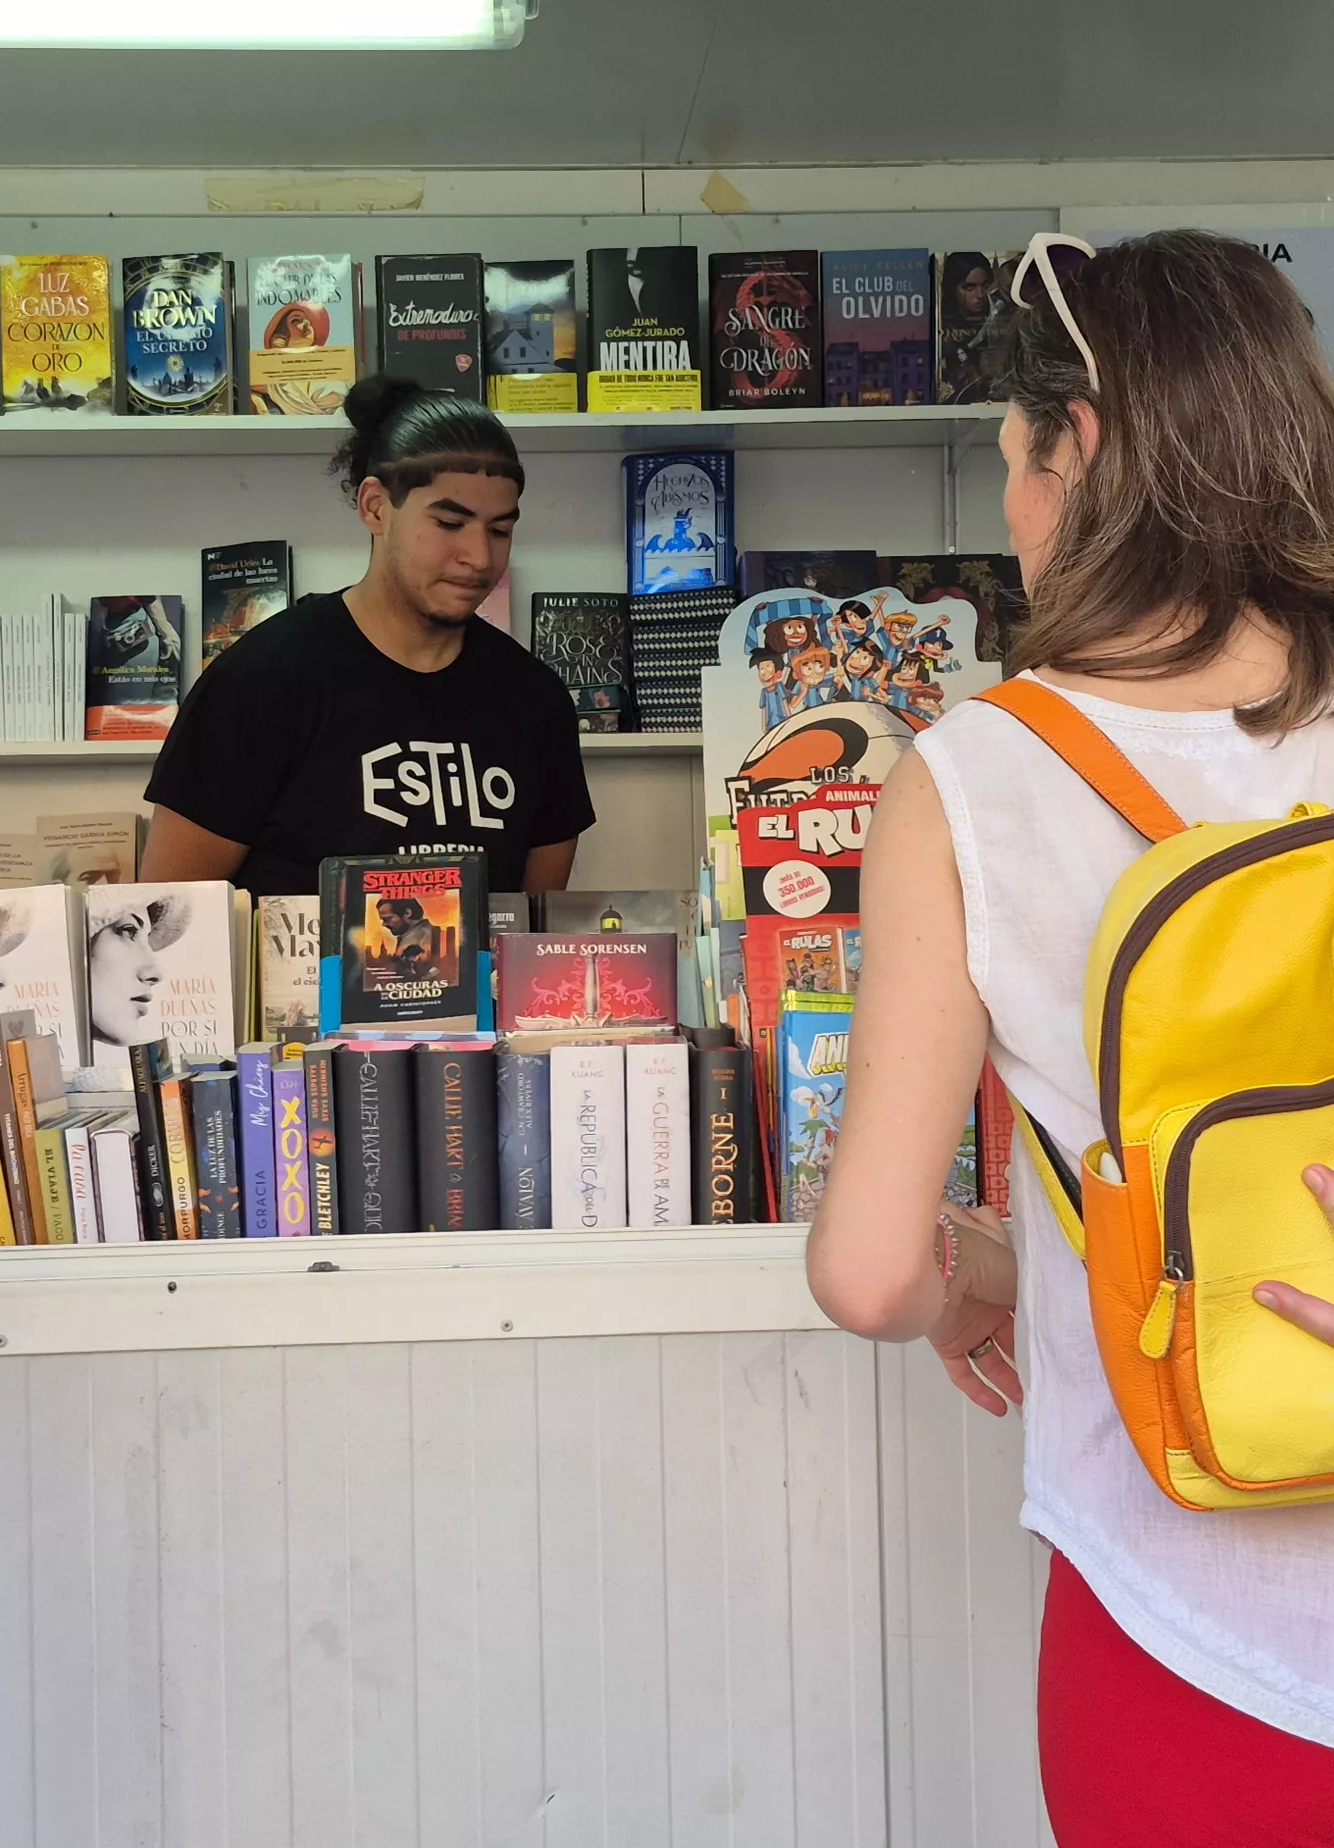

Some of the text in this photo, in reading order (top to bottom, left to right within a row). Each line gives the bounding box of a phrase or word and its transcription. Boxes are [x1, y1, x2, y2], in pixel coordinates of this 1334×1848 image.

[39, 273, 70, 294] LUZ
[832, 276, 914, 295] EL CLUB DEL
[154, 289, 193, 308] DAN
[841, 294, 925, 320] OLVIDO
[132, 306, 218, 329] BROWN
[631, 317, 658, 327] JUAN
[136, 331, 154, 343] EL
[397, 329, 467, 342] DE PROFUNDIS
[605, 327, 686, 339] GÓMEZ-JURADO
[142, 340, 208, 355] SECRETO
[599, 340, 692, 372] MENTIRA
[31, 352, 84, 373] ORO
[728, 388, 806, 398] BRIAR BOLEYN
[543, 596, 619, 607] JULIE SOTO
[546, 632, 618, 656] ROSE
[582, 655, 594, 667] IN
[809, 766, 851, 785] LOS
[757, 803, 874, 858] EL RU
[363, 867, 463, 892] STRANGER
[777, 875, 816, 898] 350.000
[379, 884, 446, 900] THINGS
[536, 943, 648, 957] SABLE SORENSEN
[790, 934, 833, 950] RULAS
[13, 976, 60, 1000] MARÍA
[169, 973, 216, 996] MARÍA
[293, 976, 302, 986] el
[373, 979, 449, 992] A OSCURAS
[388, 988, 443, 1000] CIUDAD
[160, 997, 216, 1017] DUEÑAS
[48, 1021, 63, 1038] SI
[160, 1020, 218, 1038] POR SI
[571, 1070, 605, 1078] KUANG
[644, 1066, 677, 1076] KUANG
[443, 1061, 466, 1170] CALLIE HART
[652, 1101, 670, 1175] GUERRA
[578, 1104, 599, 1194] REPÚBLICA
[147, 1144, 160, 1177] DICKER
[44, 1148, 64, 1242] EL VIAJE PACO
[255, 1169, 267, 1230] GRACIA
[315, 1162, 332, 1231] BLETCHLEY
